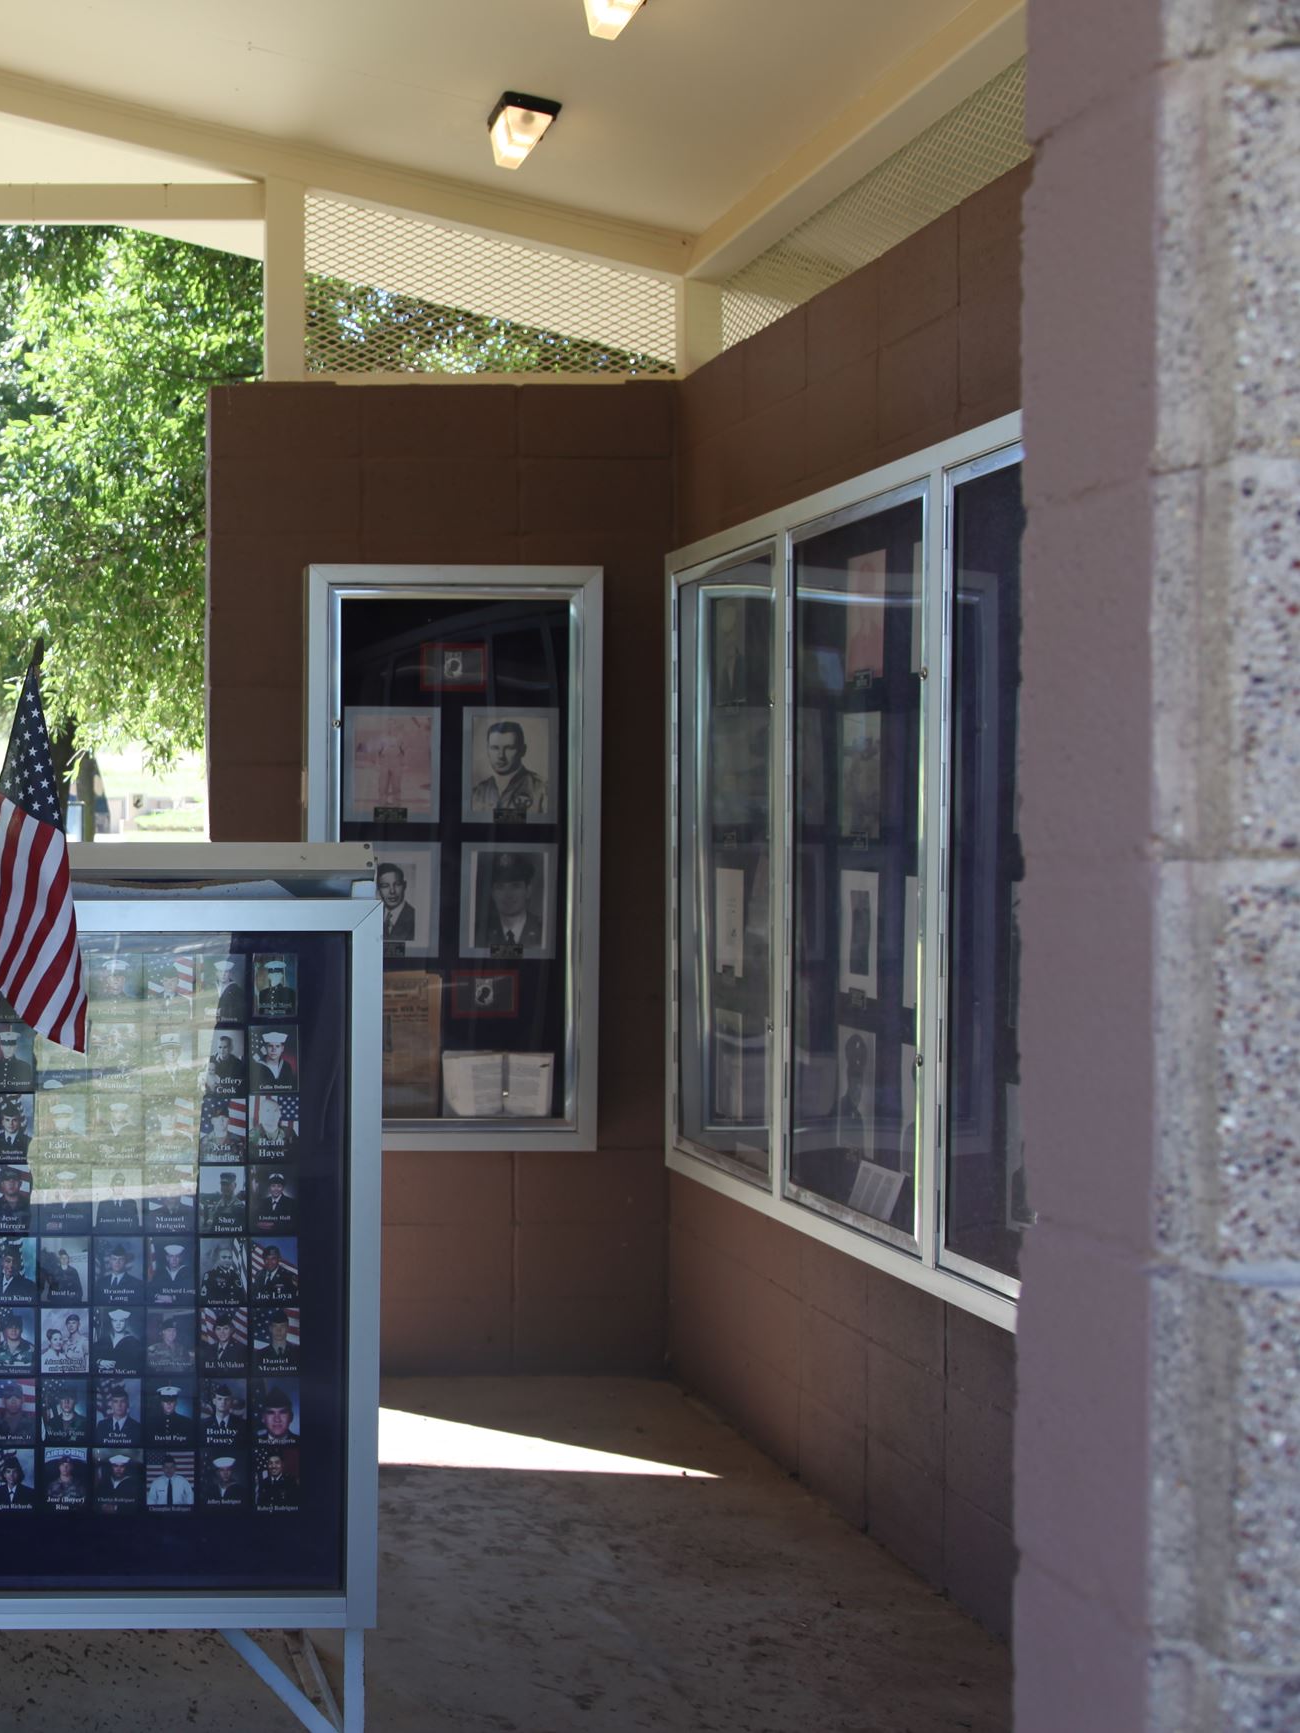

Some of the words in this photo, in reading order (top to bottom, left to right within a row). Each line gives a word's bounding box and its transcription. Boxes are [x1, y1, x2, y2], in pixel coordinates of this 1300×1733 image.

[217, 1077, 242, 1086] Jeffery
[49, 1141, 72, 1149] Eddie
[259, 1138, 284, 1146] Heath
[213, 1143, 231, 1151] Kris
[259, 1149, 284, 1157] Hayes
[272, 1292, 292, 1300] Loya
